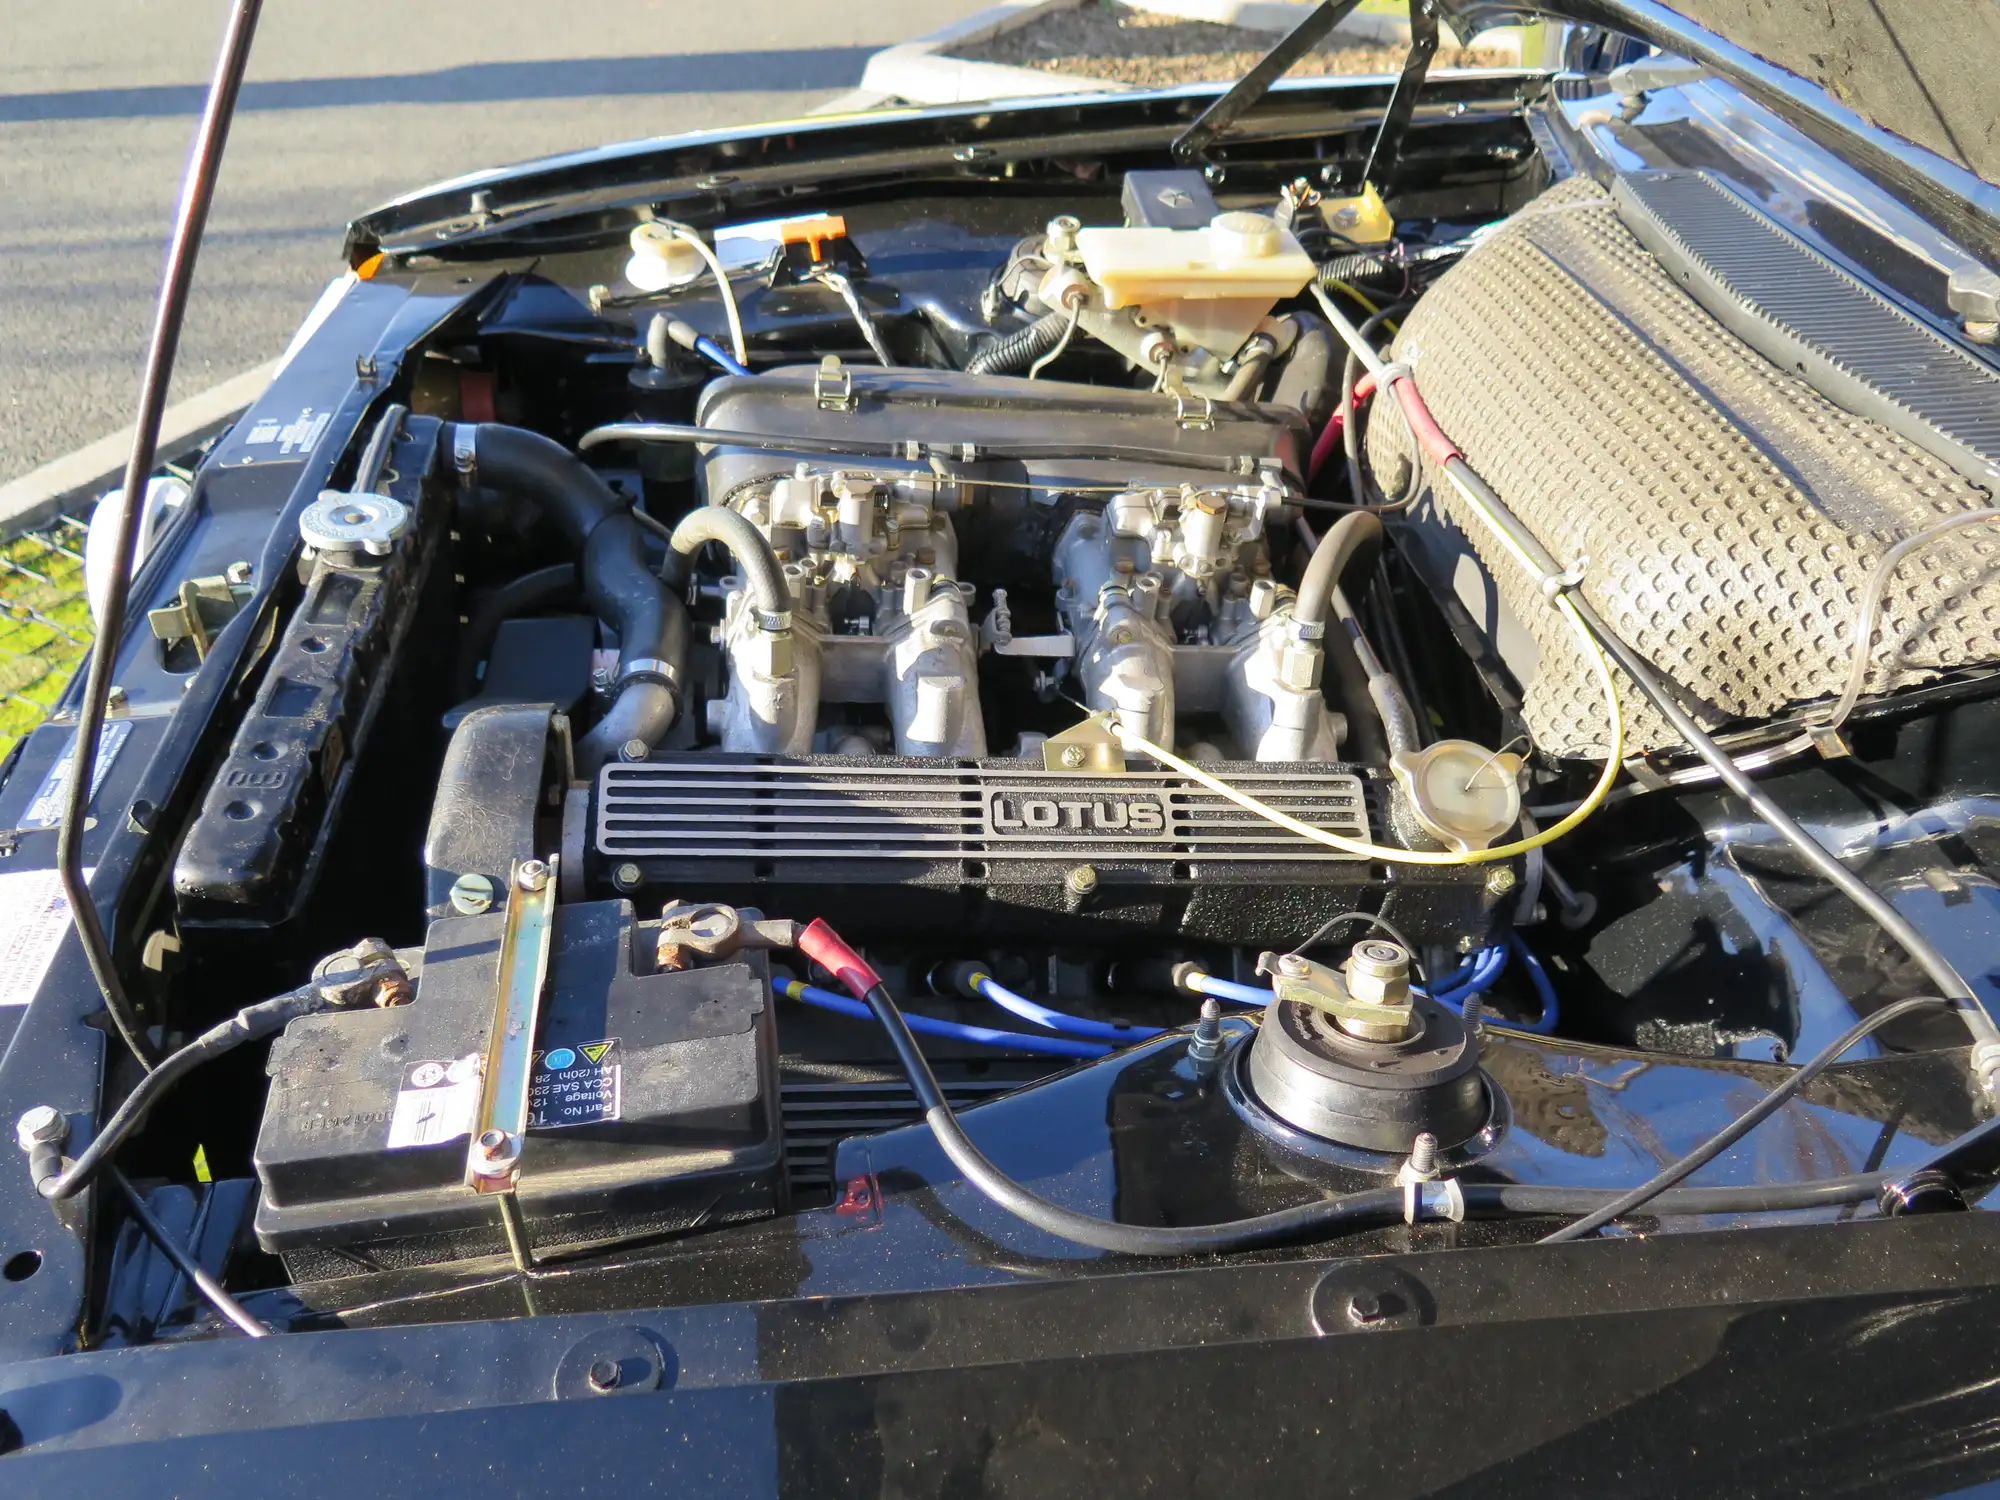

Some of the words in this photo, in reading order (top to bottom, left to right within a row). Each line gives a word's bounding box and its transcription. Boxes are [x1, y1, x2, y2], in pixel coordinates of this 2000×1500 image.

[993, 799, 1163, 829] LOTUS
[559, 1068, 590, 1080] (20h)
[594, 1065, 613, 1076] AH
[535, 1073, 552, 1083] 28
[583, 1077, 613, 1088] CCA
[552, 1081, 580, 1094] SAE
[565, 1089, 613, 1102] Voltage
[561, 1106, 582, 1116] No.
[585, 1101, 613, 1114] Part
